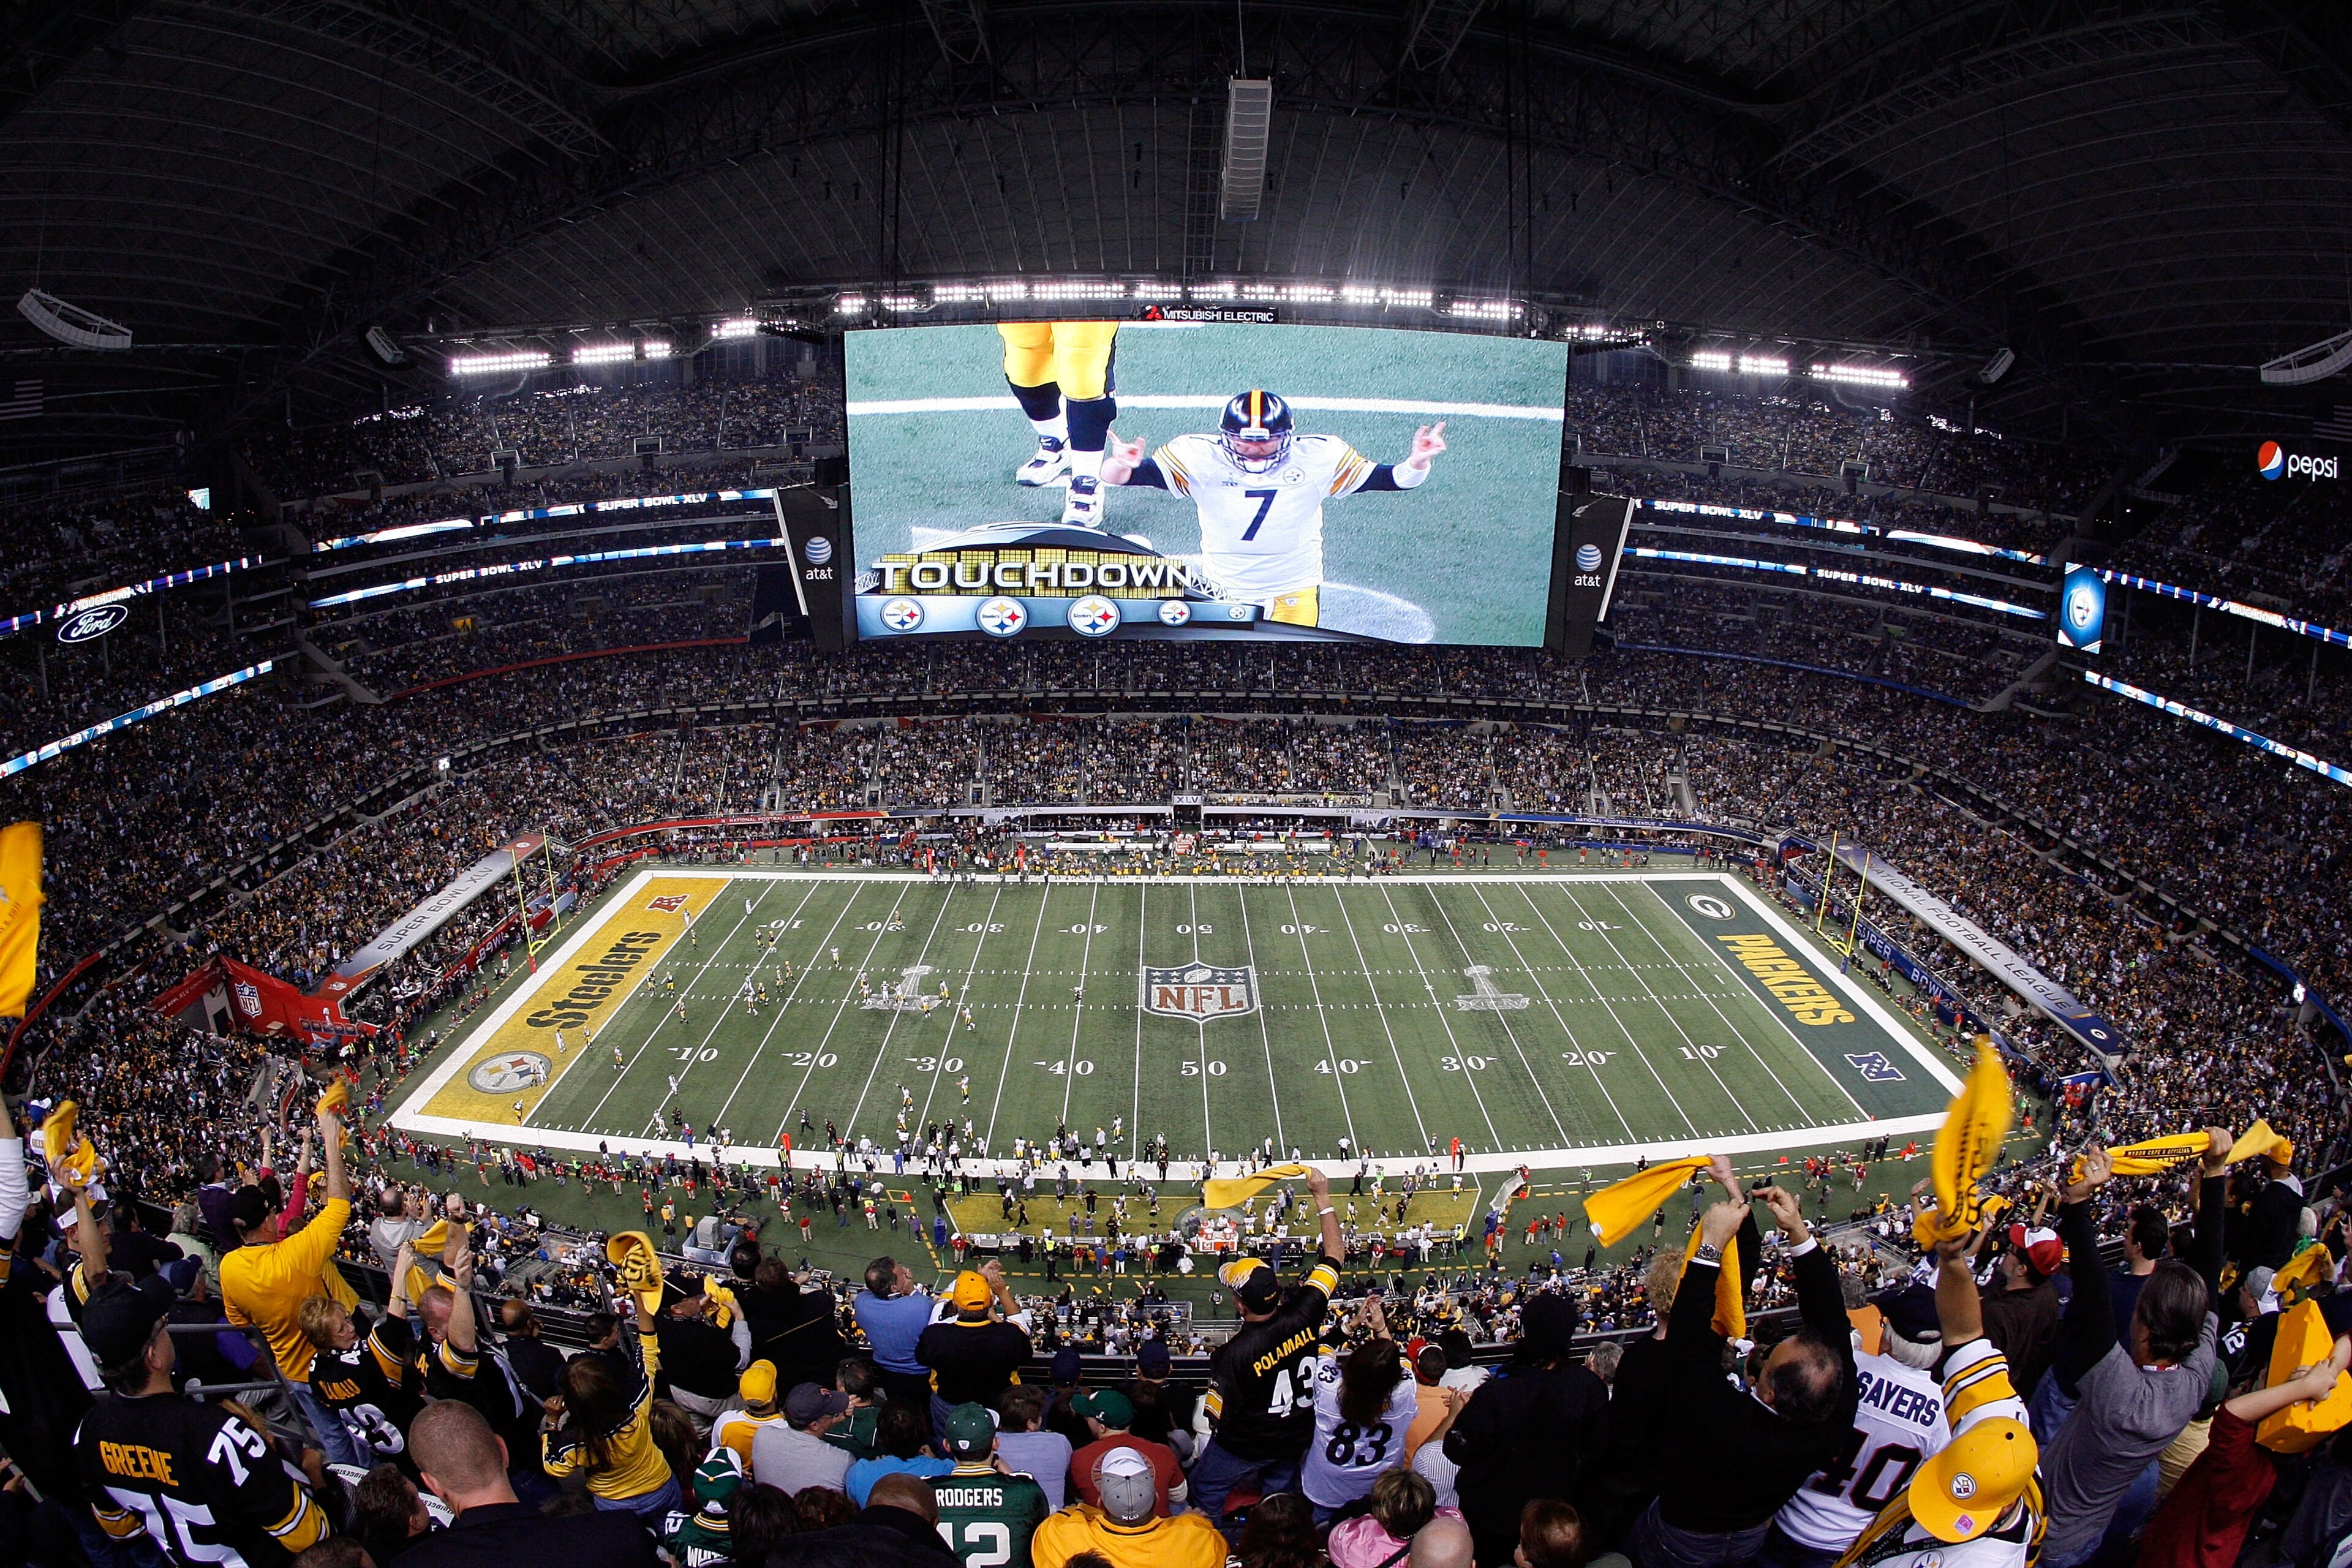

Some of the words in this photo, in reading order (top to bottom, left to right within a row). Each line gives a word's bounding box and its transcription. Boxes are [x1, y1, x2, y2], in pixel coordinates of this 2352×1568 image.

[1164, 310, 1222, 321] MITSUBISHI
[1224, 311, 1275, 323] ELECTRIC
[2288, 453, 2338, 482] pepsi
[597, 499, 639, 512] SUPER
[643, 495, 680, 508] BOWL
[682, 492, 708, 505] XLV
[1654, 500, 1696, 514] SUPER
[1699, 504, 1735, 518] BOWL
[1738, 508, 1763, 521] XLV
[1243, 489, 1278, 541] 7
[435, 569, 475, 584] SUPER
[480, 564, 515, 576] BOWL
[519, 560, 543, 571] XLV
[805, 567, 833, 581] at&t
[872, 560, 1193, 589] TOUCHDOWN
[1574, 574, 1600, 587] at&t
[1816, 568, 1858, 583] SUPER
[1862, 575, 1896, 590] BOWL
[1899, 582, 1923, 594] XLV
[77, 587, 131, 611] TOUCHDOWN
[70, 610, 116, 638] Ford
[2230, 602, 2283, 627] TOUCHDOWN
[377, 914, 432, 951] SUPER
[427, 886, 470, 913] BOWL
[466, 867, 493, 884] XLV
[1689, 895, 1732, 919] G
[1176, 924, 1213, 935] 50
[1867, 862, 1928, 909] NATIONAL
[1927, 907, 2002, 960] FOOTBALL
[2005, 962, 2072, 1011] LEAGUE
[527, 931, 662, 1029] Steelers
[1716, 933, 1855, 1026] PACKERS
[178, 988, 190, 1000] XLV
[241, 996, 260, 1012] NFL
[1156, 986, 1244, 1012] NFL
[2090, 1028, 2109, 1041] G
[676, 1047, 718, 1062] 10
[791, 1051, 839, 1068] 20
[1441, 1055, 1488, 1071] 30
[1562, 1050, 1608, 1067] 20
[1678, 1045, 1719, 1060] 10
[916, 1056, 964, 1073] 30
[1048, 1060, 1095, 1076] 40
[1180, 1060, 1227, 1076] 50
[1314, 1058, 1360, 1075] 40
[1317, 1365, 1339, 1384] 83
[1268, 1356, 1317, 1417] 43
[1856, 1371, 1939, 1428] SAYERS
[206, 1417, 266, 1487] 75
[1325, 1422, 1393, 1467] 83
[99, 1440, 179, 1487] GREENE
[935, 1488, 1003, 1507] RODGERS
